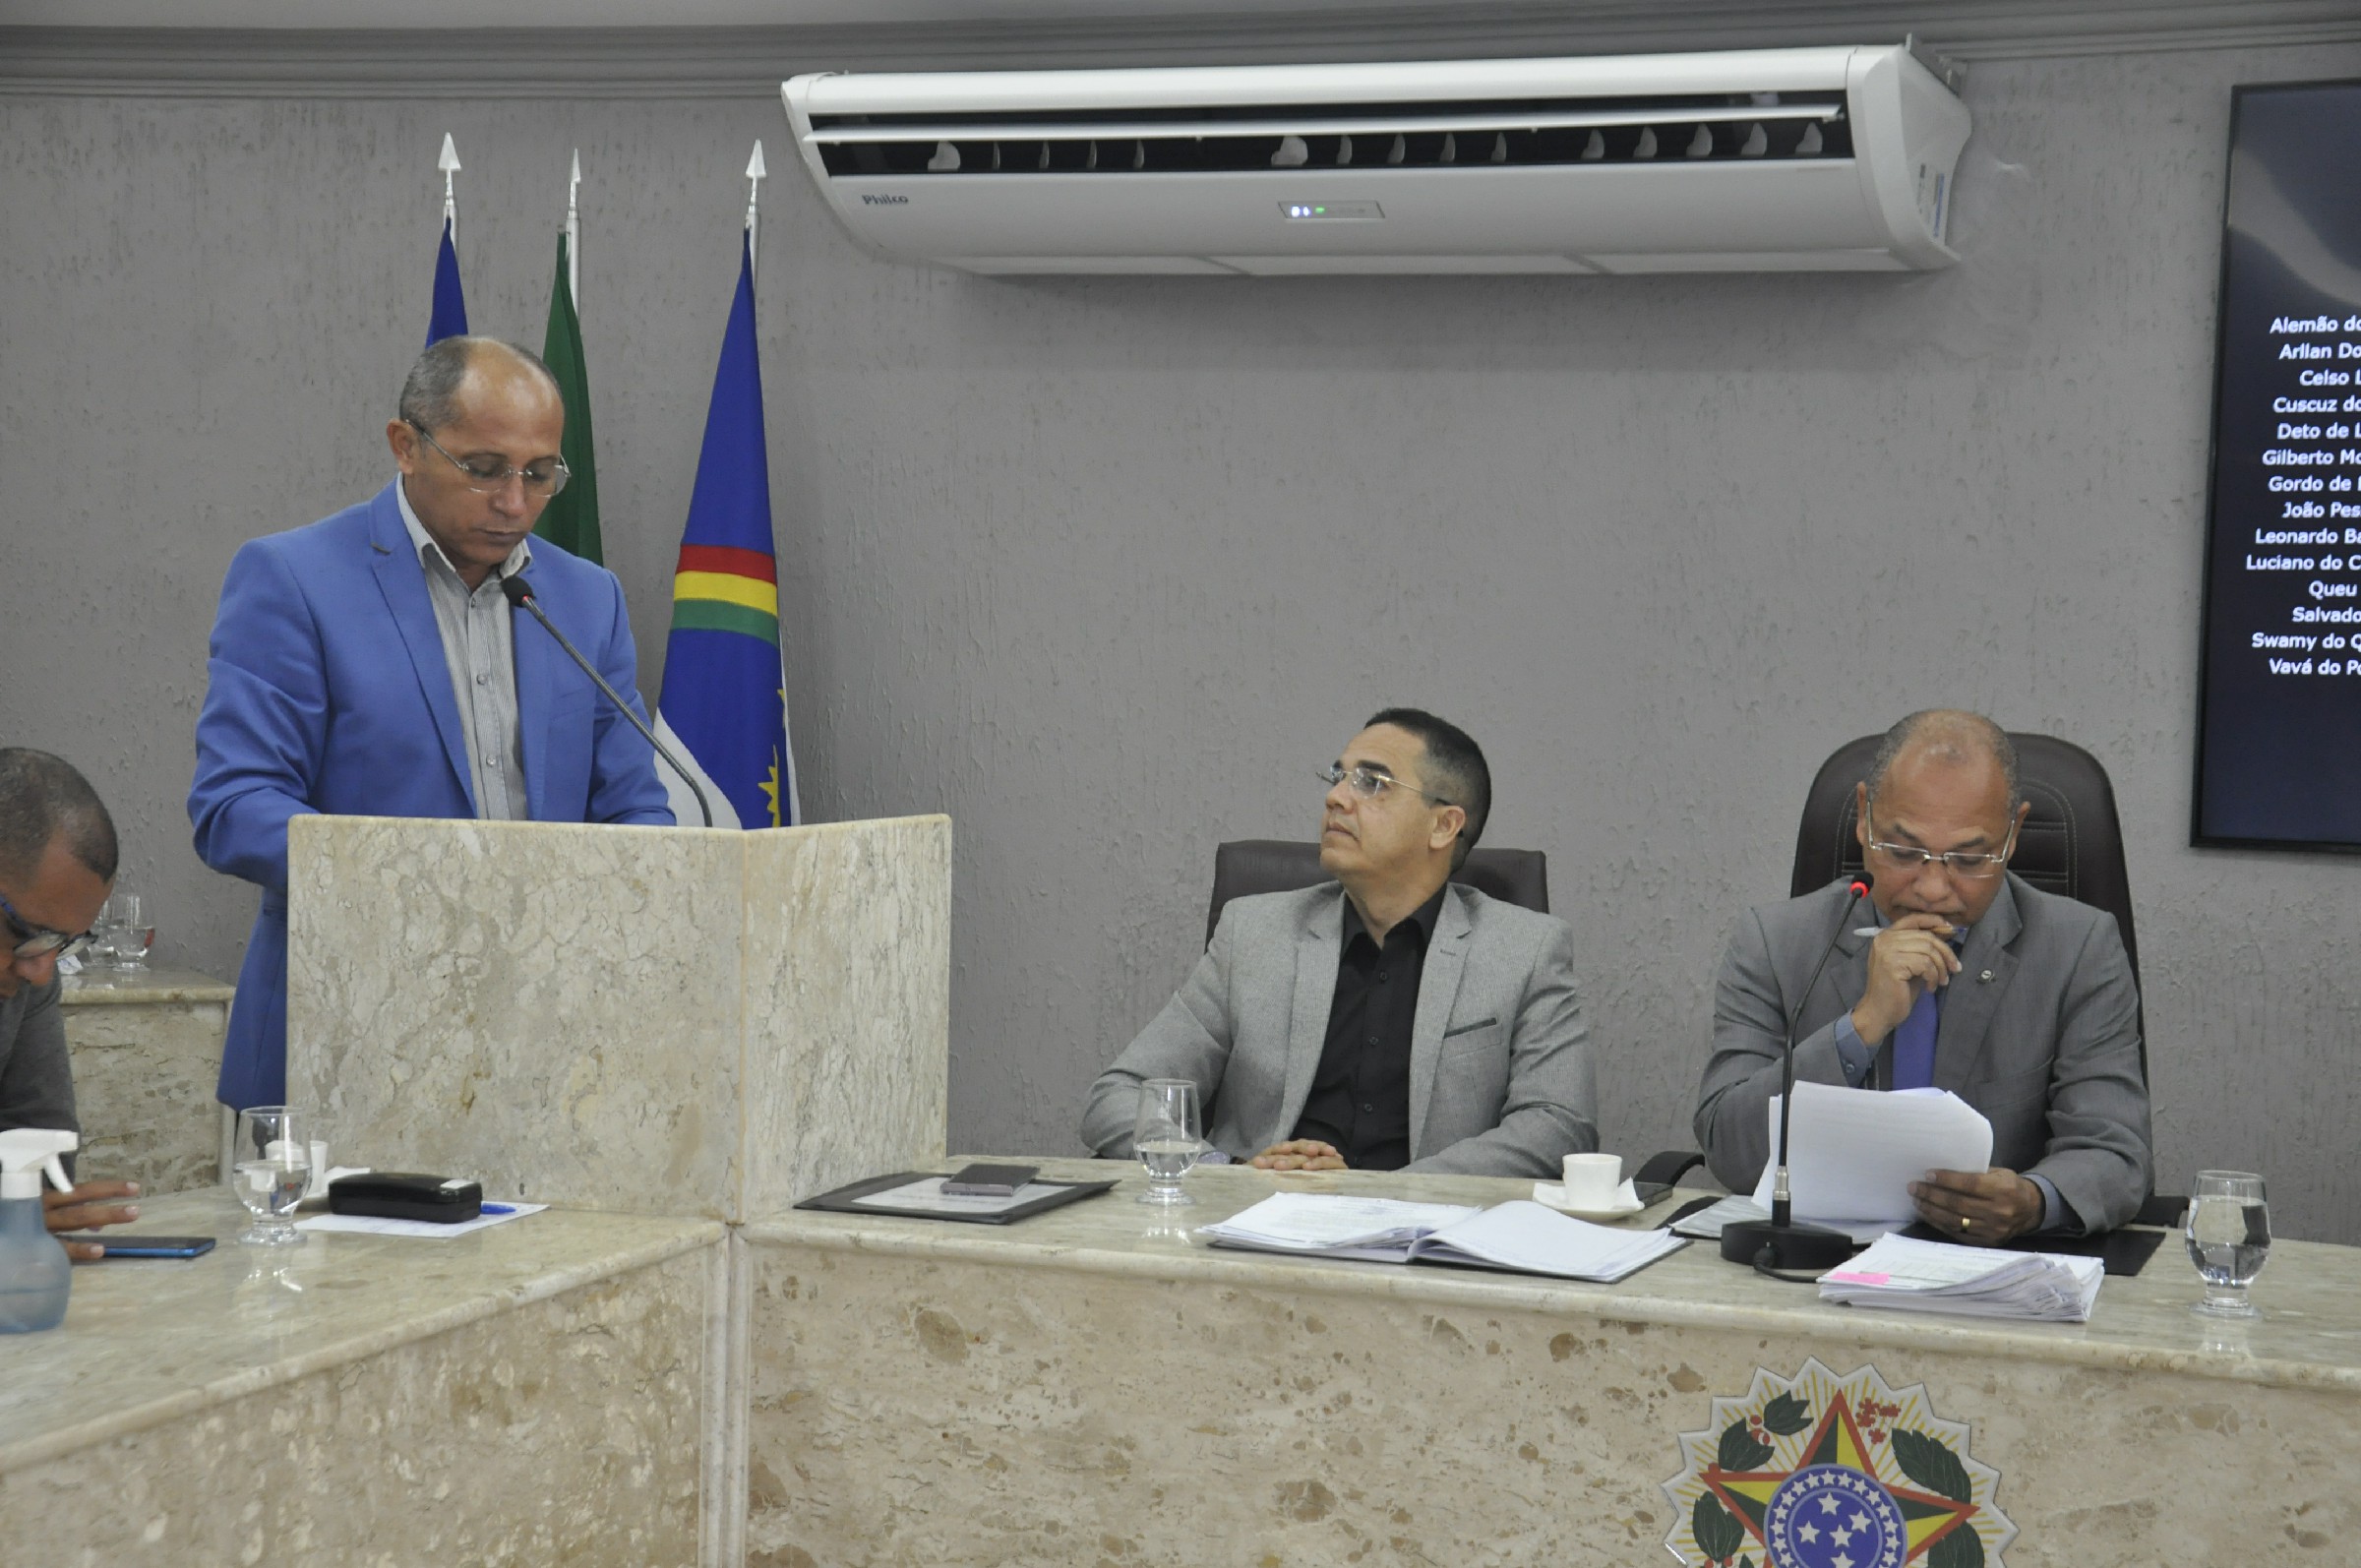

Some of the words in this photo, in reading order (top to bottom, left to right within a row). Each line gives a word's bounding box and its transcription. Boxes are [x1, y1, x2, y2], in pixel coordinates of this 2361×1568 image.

[862, 194, 909, 205] Philco
[2270, 315, 2339, 334] Alemão
[2299, 369, 2350, 387] Celso
[2272, 396, 2338, 413] Cuscuz
[2277, 423, 2322, 440] Deto
[2327, 422, 2350, 439] de
[2262, 450, 2335, 466] Gilberto
[2268, 475, 2325, 492] Gordo
[2330, 475, 2352, 492] de
[2281, 501, 2326, 518] João
[2255, 527, 2339, 545] Leonardo
[2246, 554, 2315, 571] Luciano
[2320, 554, 2343, 571] do
[2348, 555, 2361, 571] C
[2309, 580, 2358, 600] Queu
[2292, 606, 2361, 623] Salvado
[2252, 633, 2318, 652] Swamy
[2323, 633, 2346, 649] do
[2269, 658, 2313, 675] Vavá
[2318, 658, 2341, 676] do
